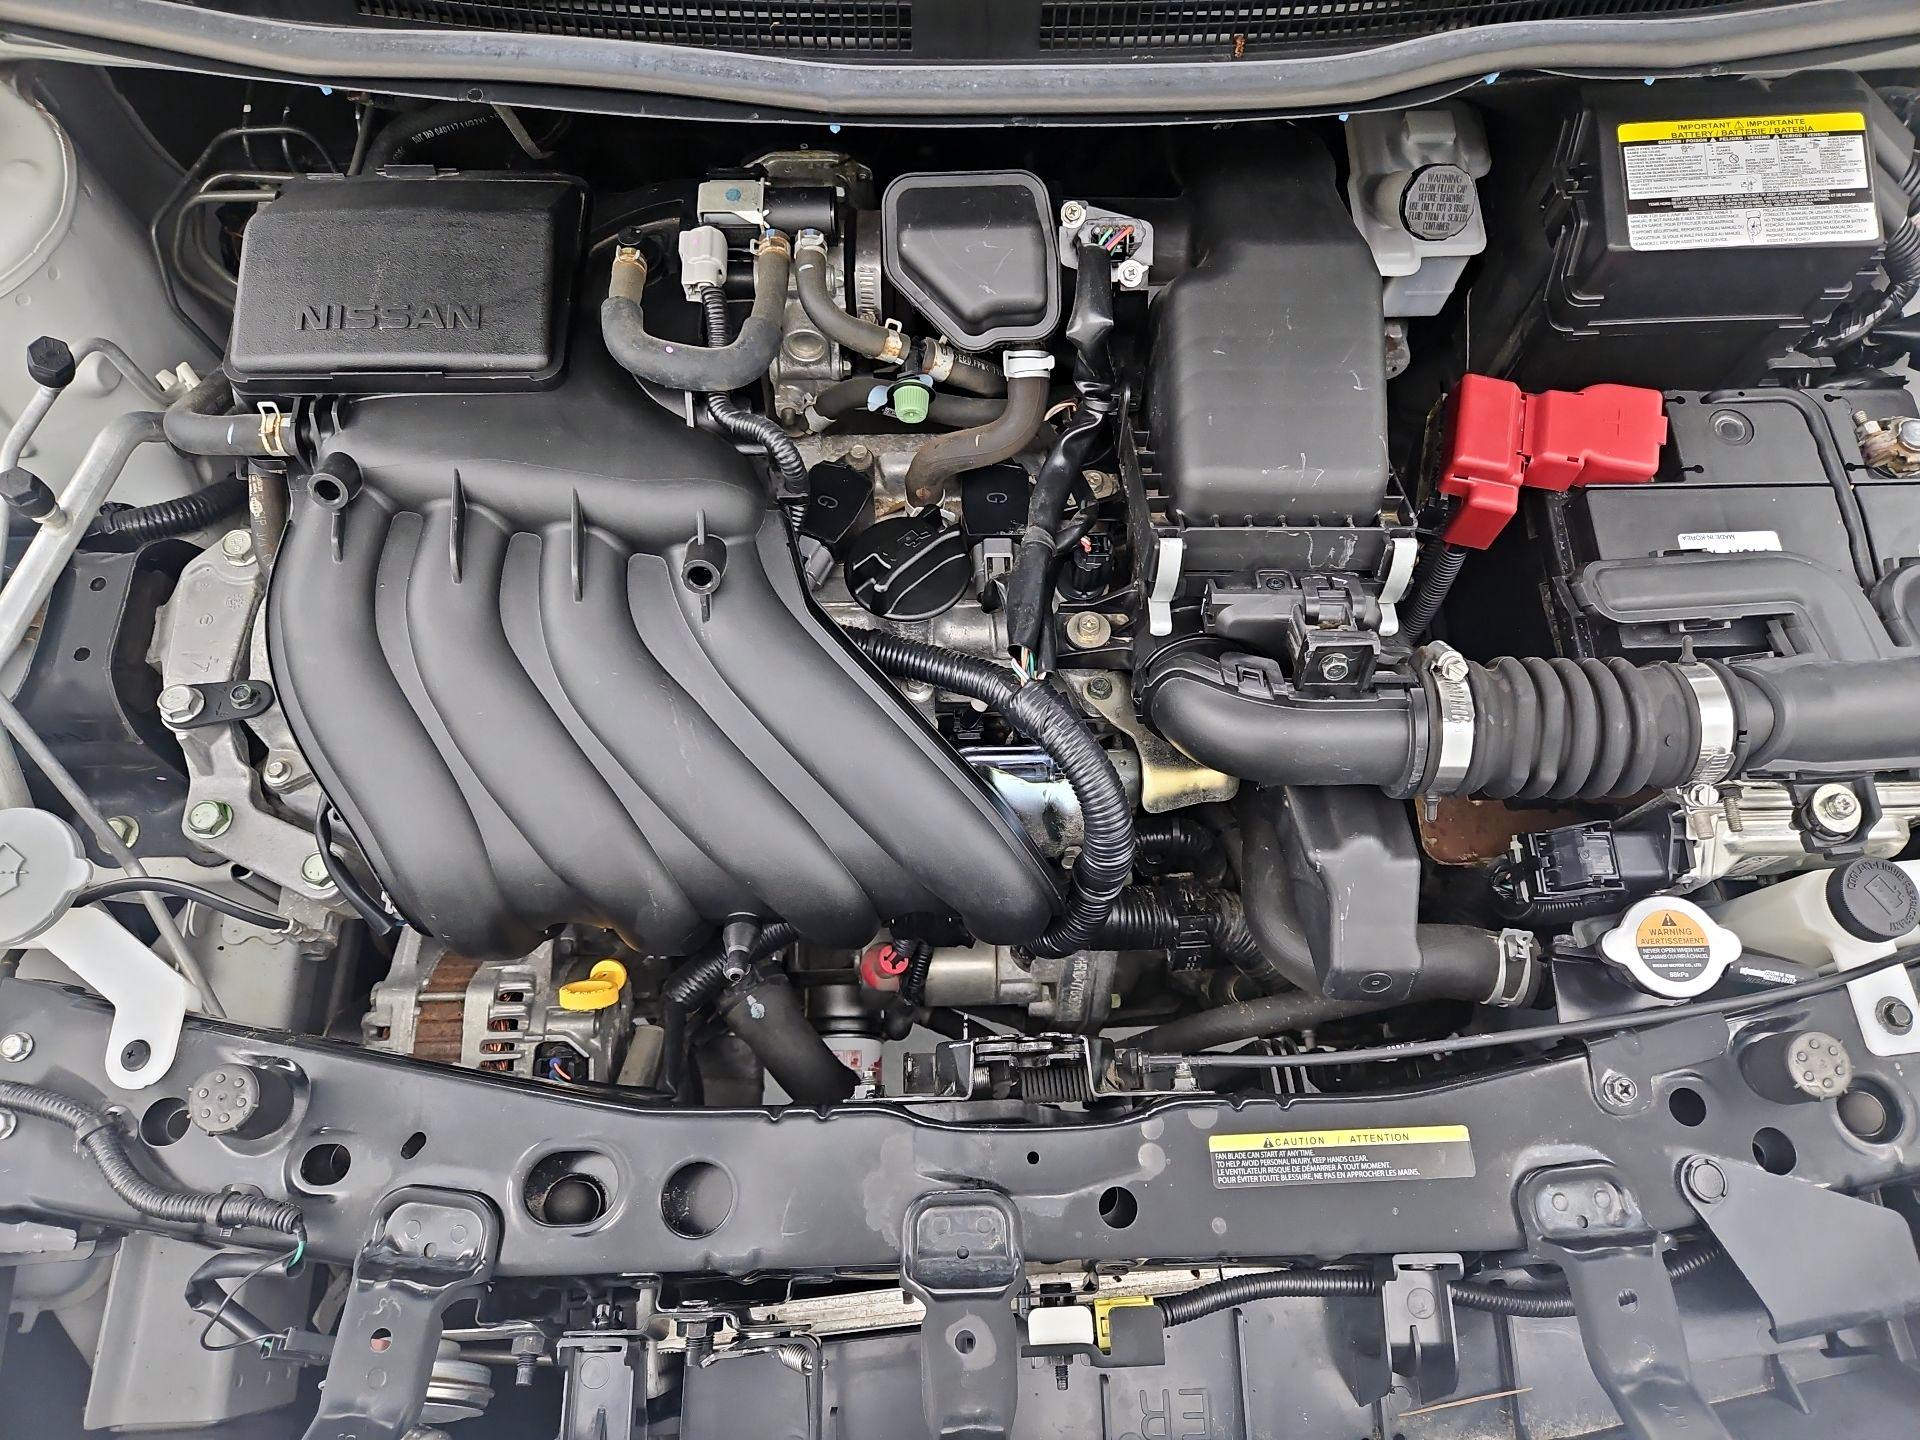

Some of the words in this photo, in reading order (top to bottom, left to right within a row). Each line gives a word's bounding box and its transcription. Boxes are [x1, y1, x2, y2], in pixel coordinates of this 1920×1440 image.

[1677, 121, 1731, 130] IMPORTANT
[1746, 118, 1806, 127] IMPORTANTE
[1671, 130, 1714, 139] BATTERY
[1721, 127, 1766, 136] BATTERIE
[295, 303, 481, 330] NISSAN
[1648, 928, 1692, 936] WARNING
[1275, 1137, 1325, 1146] CAUTION
[1350, 1133, 1409, 1142] ATTENTION
[1215, 1152, 1227, 1160] FAN
[1227, 1151, 1247, 1160] BLADE
[1260, 1150, 1278, 1158] START
[1287, 1149, 1299, 1157] ANY
[1216, 1160, 1225, 1168] TO
[1225, 1160, 1241, 1168] HELP
[1241, 1159, 1260, 1167] AVOID
[1260, 1158, 1290, 1166] PERSONAL
[1312, 1156, 1326, 1164] KEEP
[1327, 1155, 1348, 1163] HANDS
[1348, 1154, 1368, 1162] CLEAR.
[1217, 1168, 1225, 1176] LE
[1225, 1167, 1267, 1176] VENTILATEUR
[1267, 1166, 1291, 1175] RISQUE
[1292, 1165, 1301, 1173] DE
[1301, 1163, 1336, 1172] DÉMARRER
[1343, 1162, 1360, 1170] TOUT
[1361, 1161, 1392, 1169] MOMENT.
[1218, 1176, 1237, 1184] POUR
[1237, 1174, 1259, 1183] ÉVITER
[1259, 1174, 1280, 1182] TOUTE
[1280, 1173, 1314, 1181] BLESSURE,
[1347, 1170, 1385, 1178] APPROCHER
[1398, 1168, 1420, 1176] MAINS.
